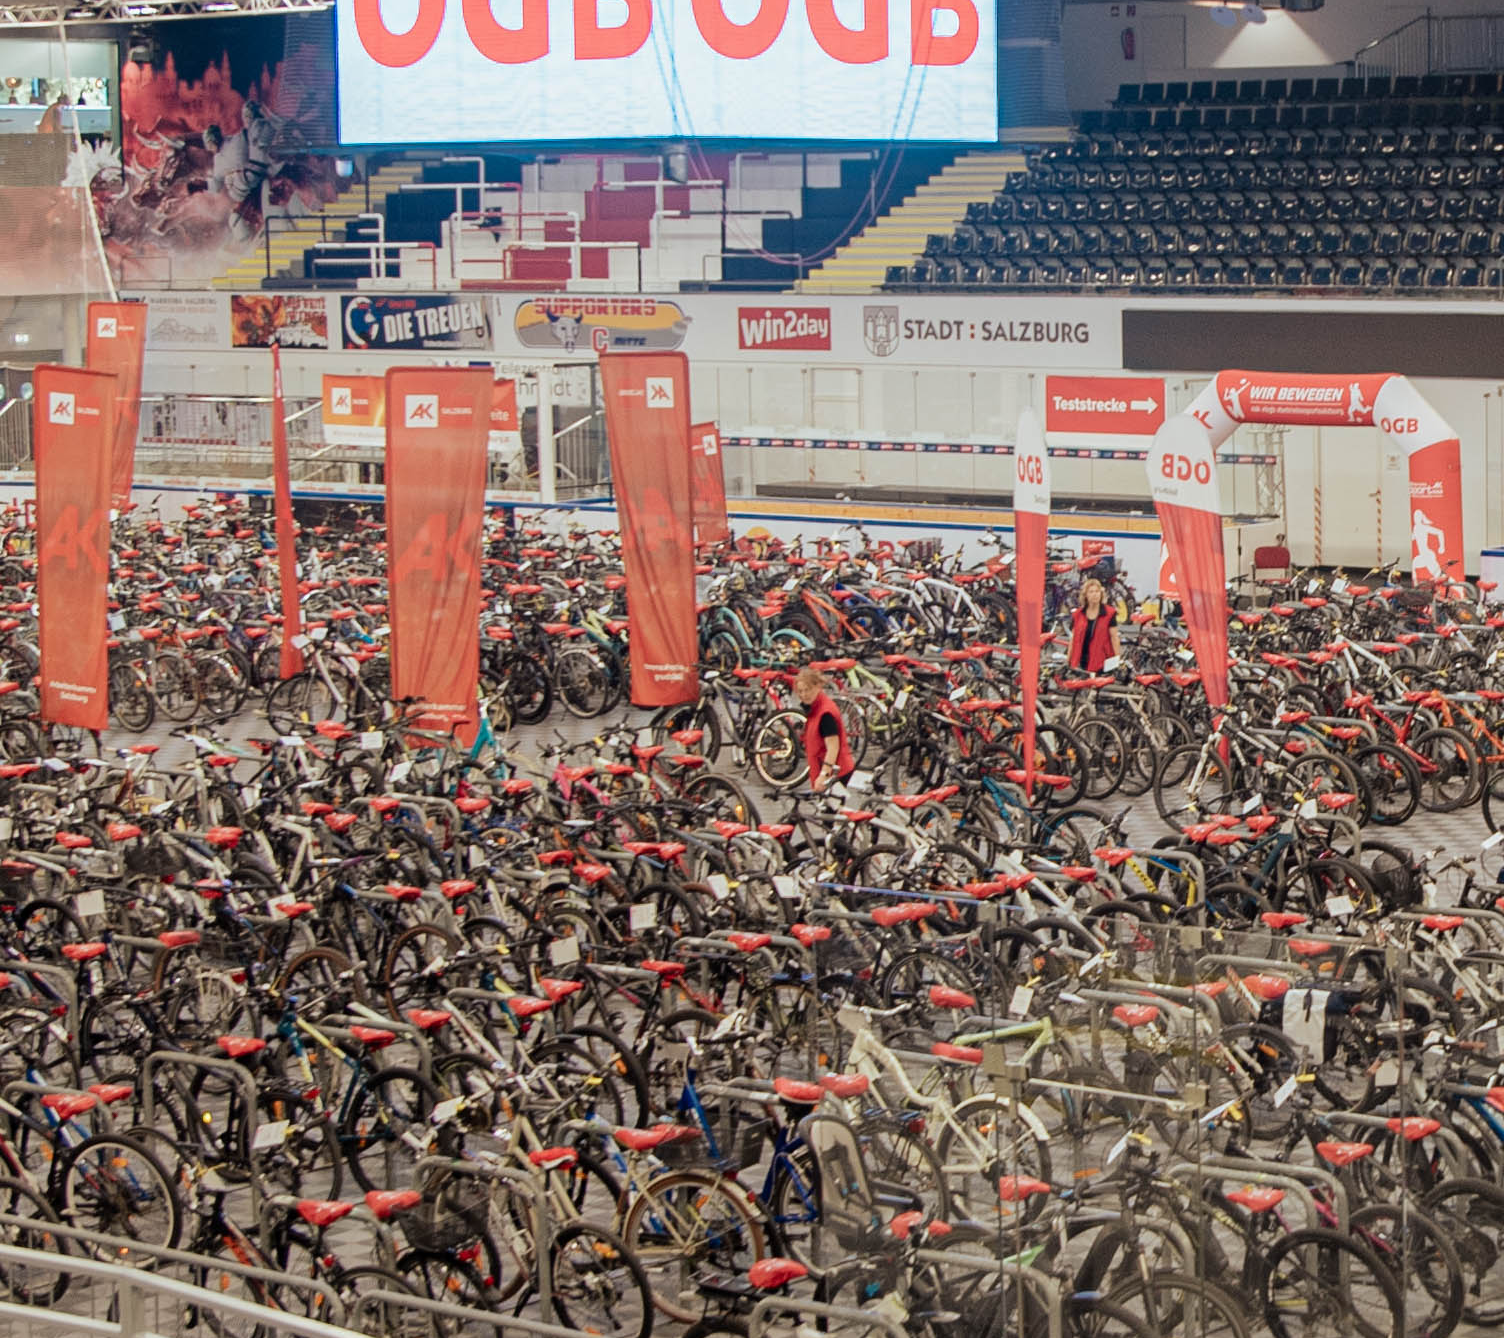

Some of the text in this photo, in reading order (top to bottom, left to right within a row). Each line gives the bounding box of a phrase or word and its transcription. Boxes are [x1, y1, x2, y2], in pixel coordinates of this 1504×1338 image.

[535, 299, 656, 317] SUPPORTERS
[383, 301, 484, 343] DIE TREUEN
[741, 310, 829, 348] win2day
[903, 320, 963, 341] STADT
[981, 321, 1089, 344] SALZBURG
[1249, 386, 1343, 402] WIR BEWEGEN
[54, 402, 72, 416] AK
[410, 403, 434, 420] AK
[1052, 397, 1127, 414] Teststrecke
[40, 503, 109, 573] AK
